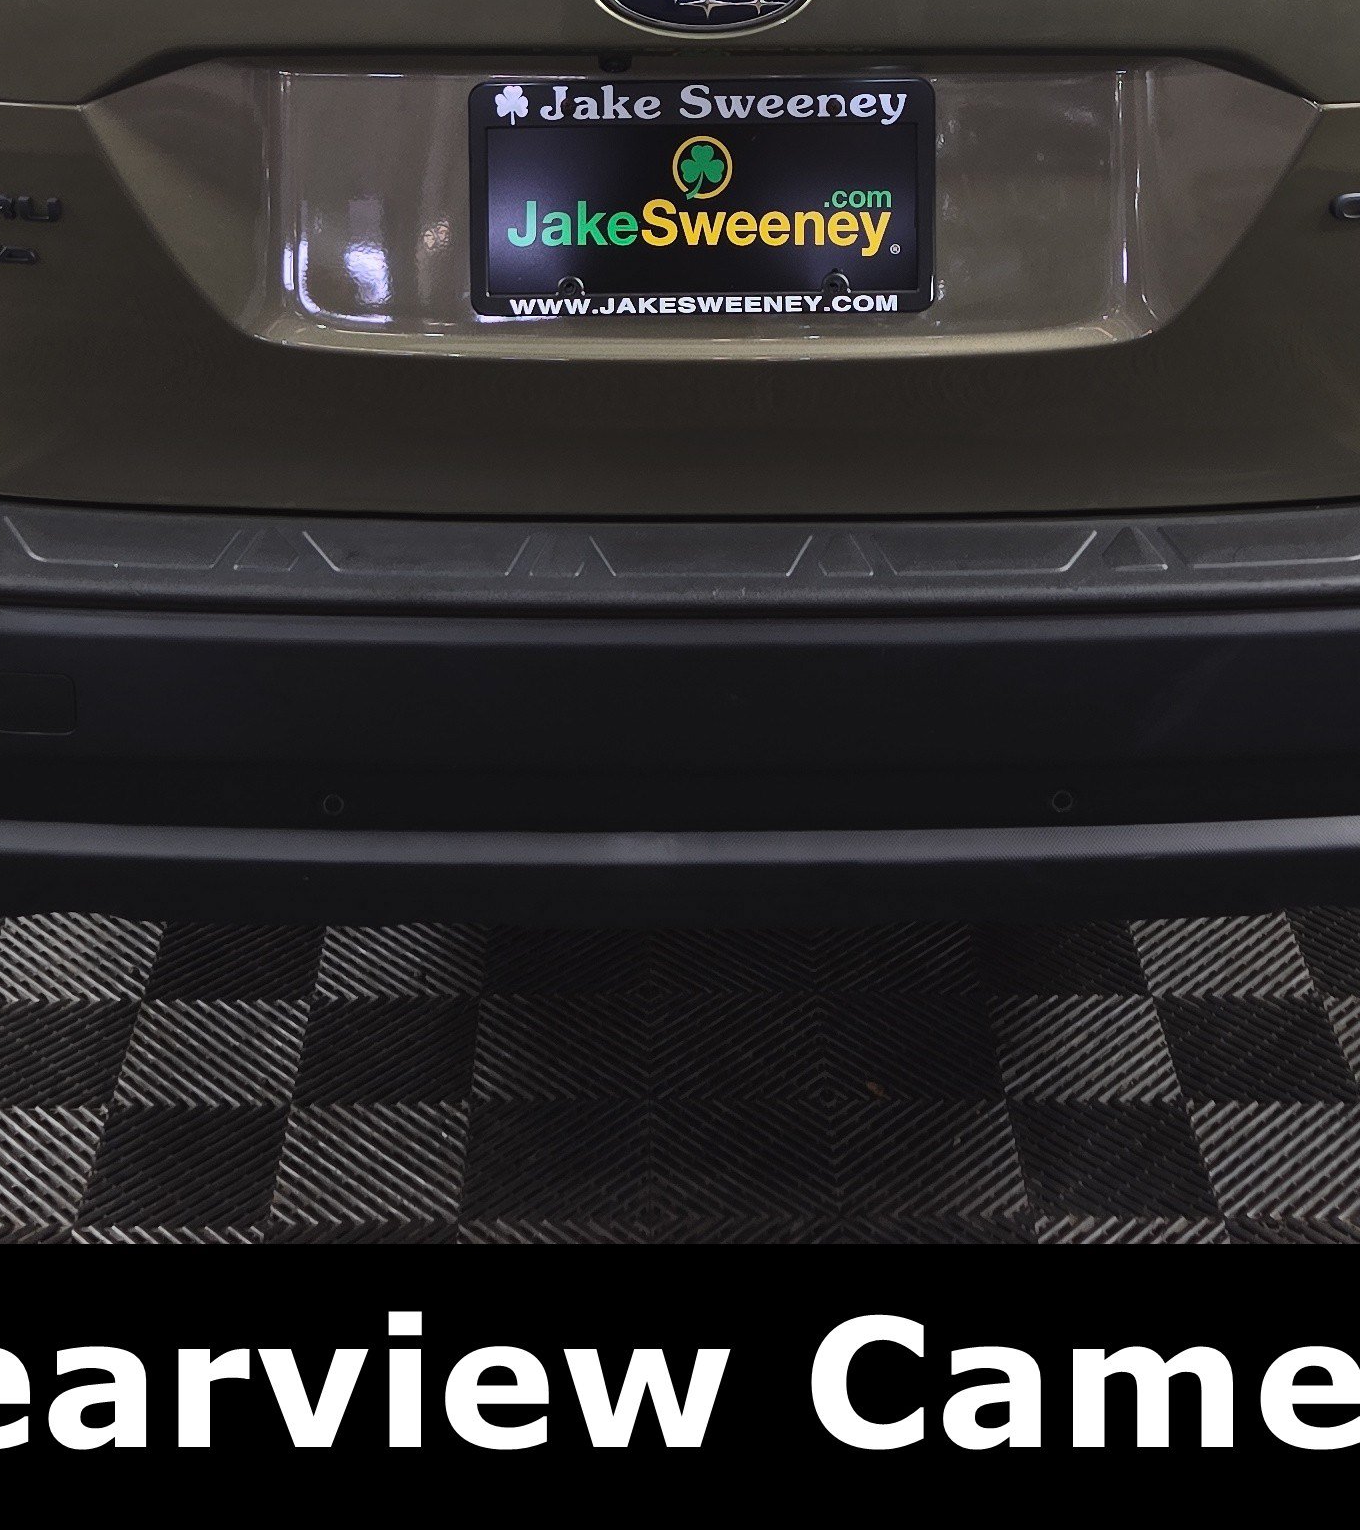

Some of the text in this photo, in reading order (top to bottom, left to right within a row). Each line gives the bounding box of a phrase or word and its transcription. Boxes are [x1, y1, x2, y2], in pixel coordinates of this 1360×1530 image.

[539, 83, 908, 125] Jake Sweeney
[509, 294, 899, 316] WWW.JAKESWEENEY.COM
